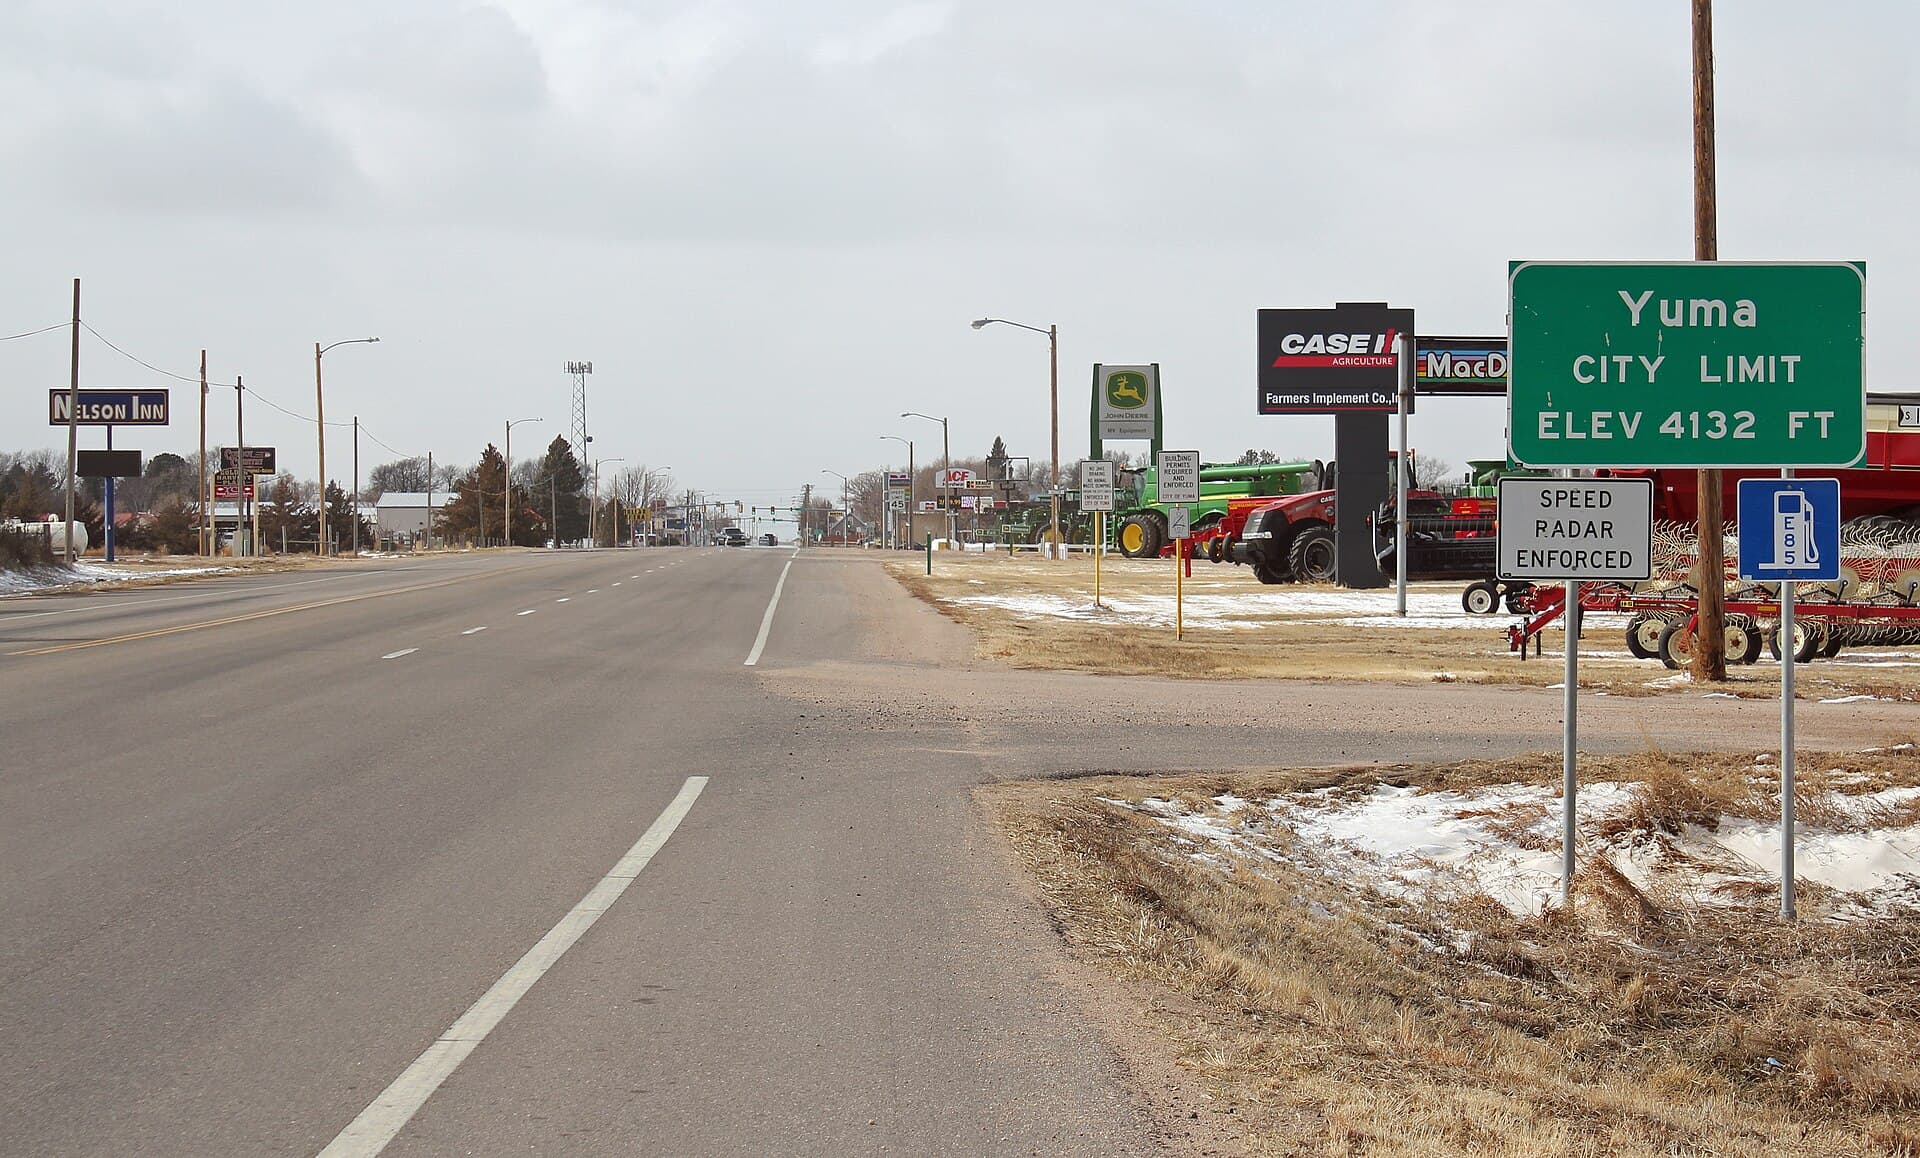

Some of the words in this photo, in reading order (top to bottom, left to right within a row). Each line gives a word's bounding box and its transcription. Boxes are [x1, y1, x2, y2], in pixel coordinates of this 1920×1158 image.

[1617, 290, 1757, 327] Yuma
[1280, 333, 1371, 355] CASE
[1332, 357, 1393, 366] AGRICULTURE
[1573, 355, 1665, 384] CITY
[1700, 355, 1802, 384] LIMIT
[1266, 392, 1310, 404] Farmers
[1313, 392, 1370, 406] Implement
[1538, 411, 1642, 440] ELEV
[1659, 411, 1757, 440] 4132
[1788, 411, 1835, 440] FT
[891, 500, 904, 508] 45
[1540, 490, 1613, 509] SPEED
[1535, 520, 1614, 539] RADAR
[1516, 550, 1633, 569] ENFORCED
